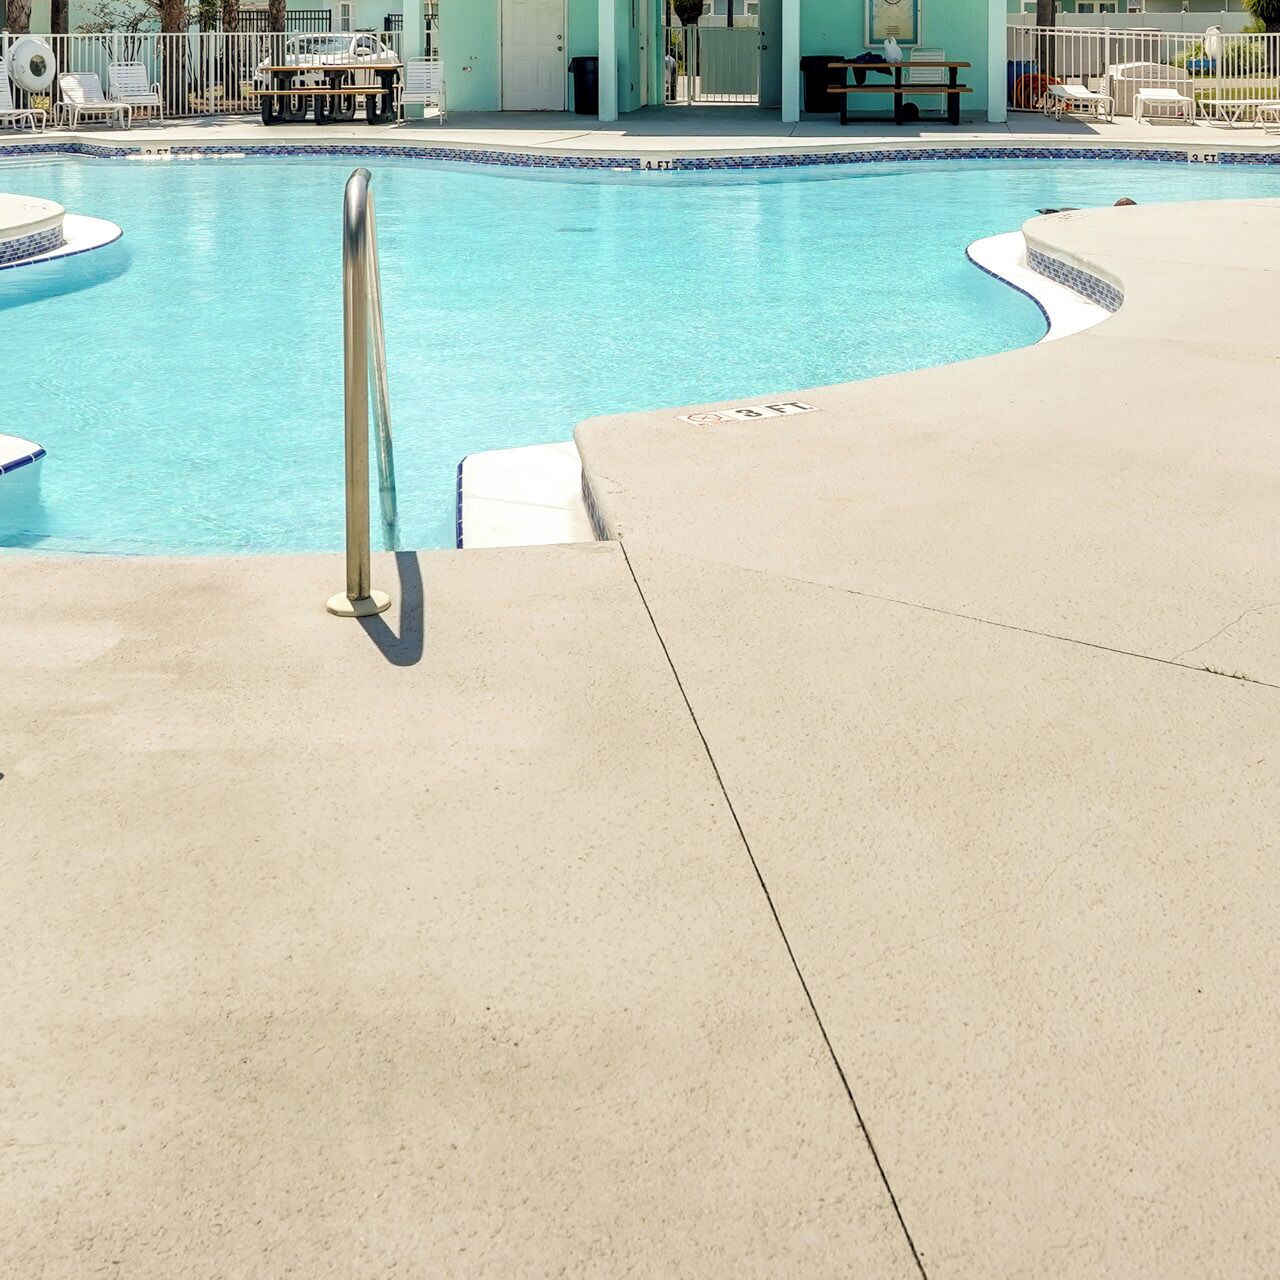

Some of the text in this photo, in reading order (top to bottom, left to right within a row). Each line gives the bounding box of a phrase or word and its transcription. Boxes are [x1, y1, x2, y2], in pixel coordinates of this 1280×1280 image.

[645, 161, 671, 169] 4 FT
[735, 409, 763, 418] 3
